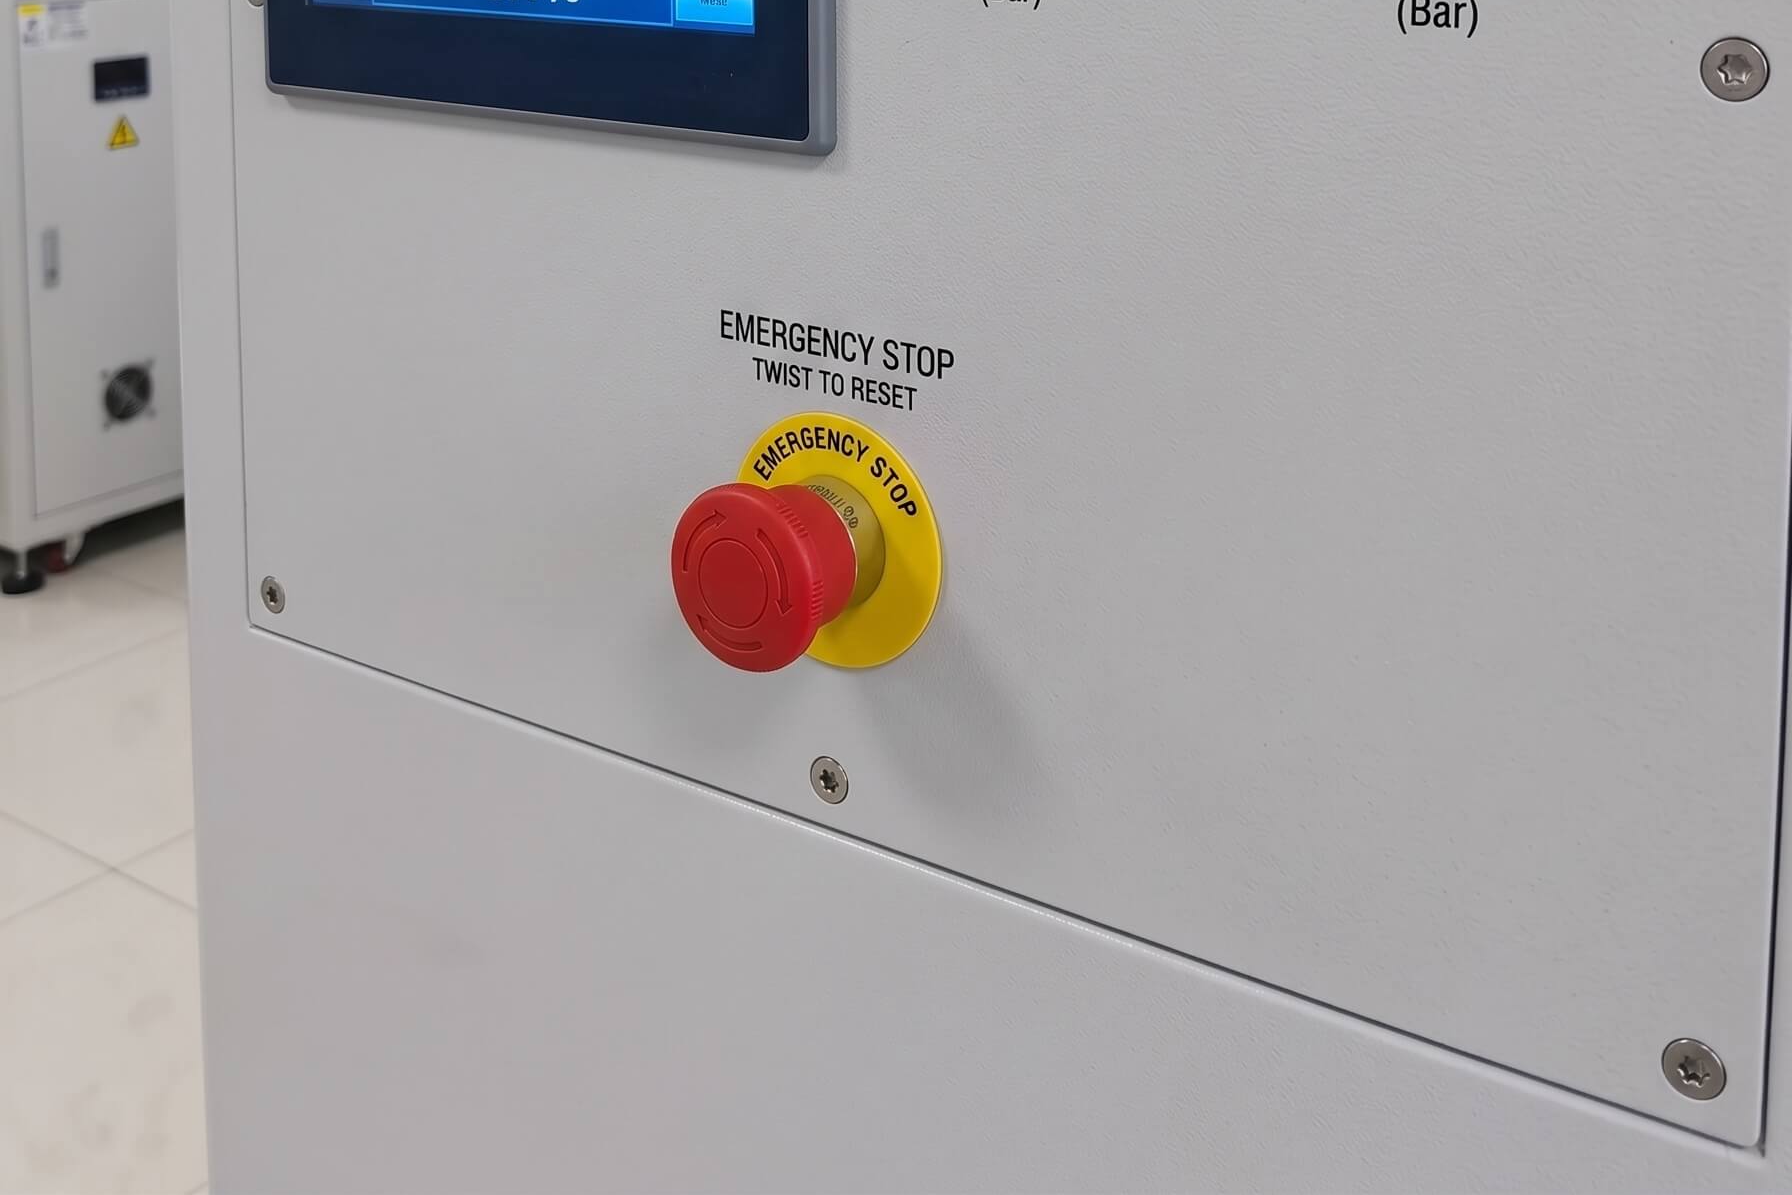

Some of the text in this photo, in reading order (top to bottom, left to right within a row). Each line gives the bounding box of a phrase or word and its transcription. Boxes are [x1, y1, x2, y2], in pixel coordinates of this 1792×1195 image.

[720, 309, 955, 380] EMERGENCY STOP
[752, 356, 917, 411] TWIST TO RESET
[753, 426, 870, 481] EMERGENCY
[870, 456, 918, 517] STOP
